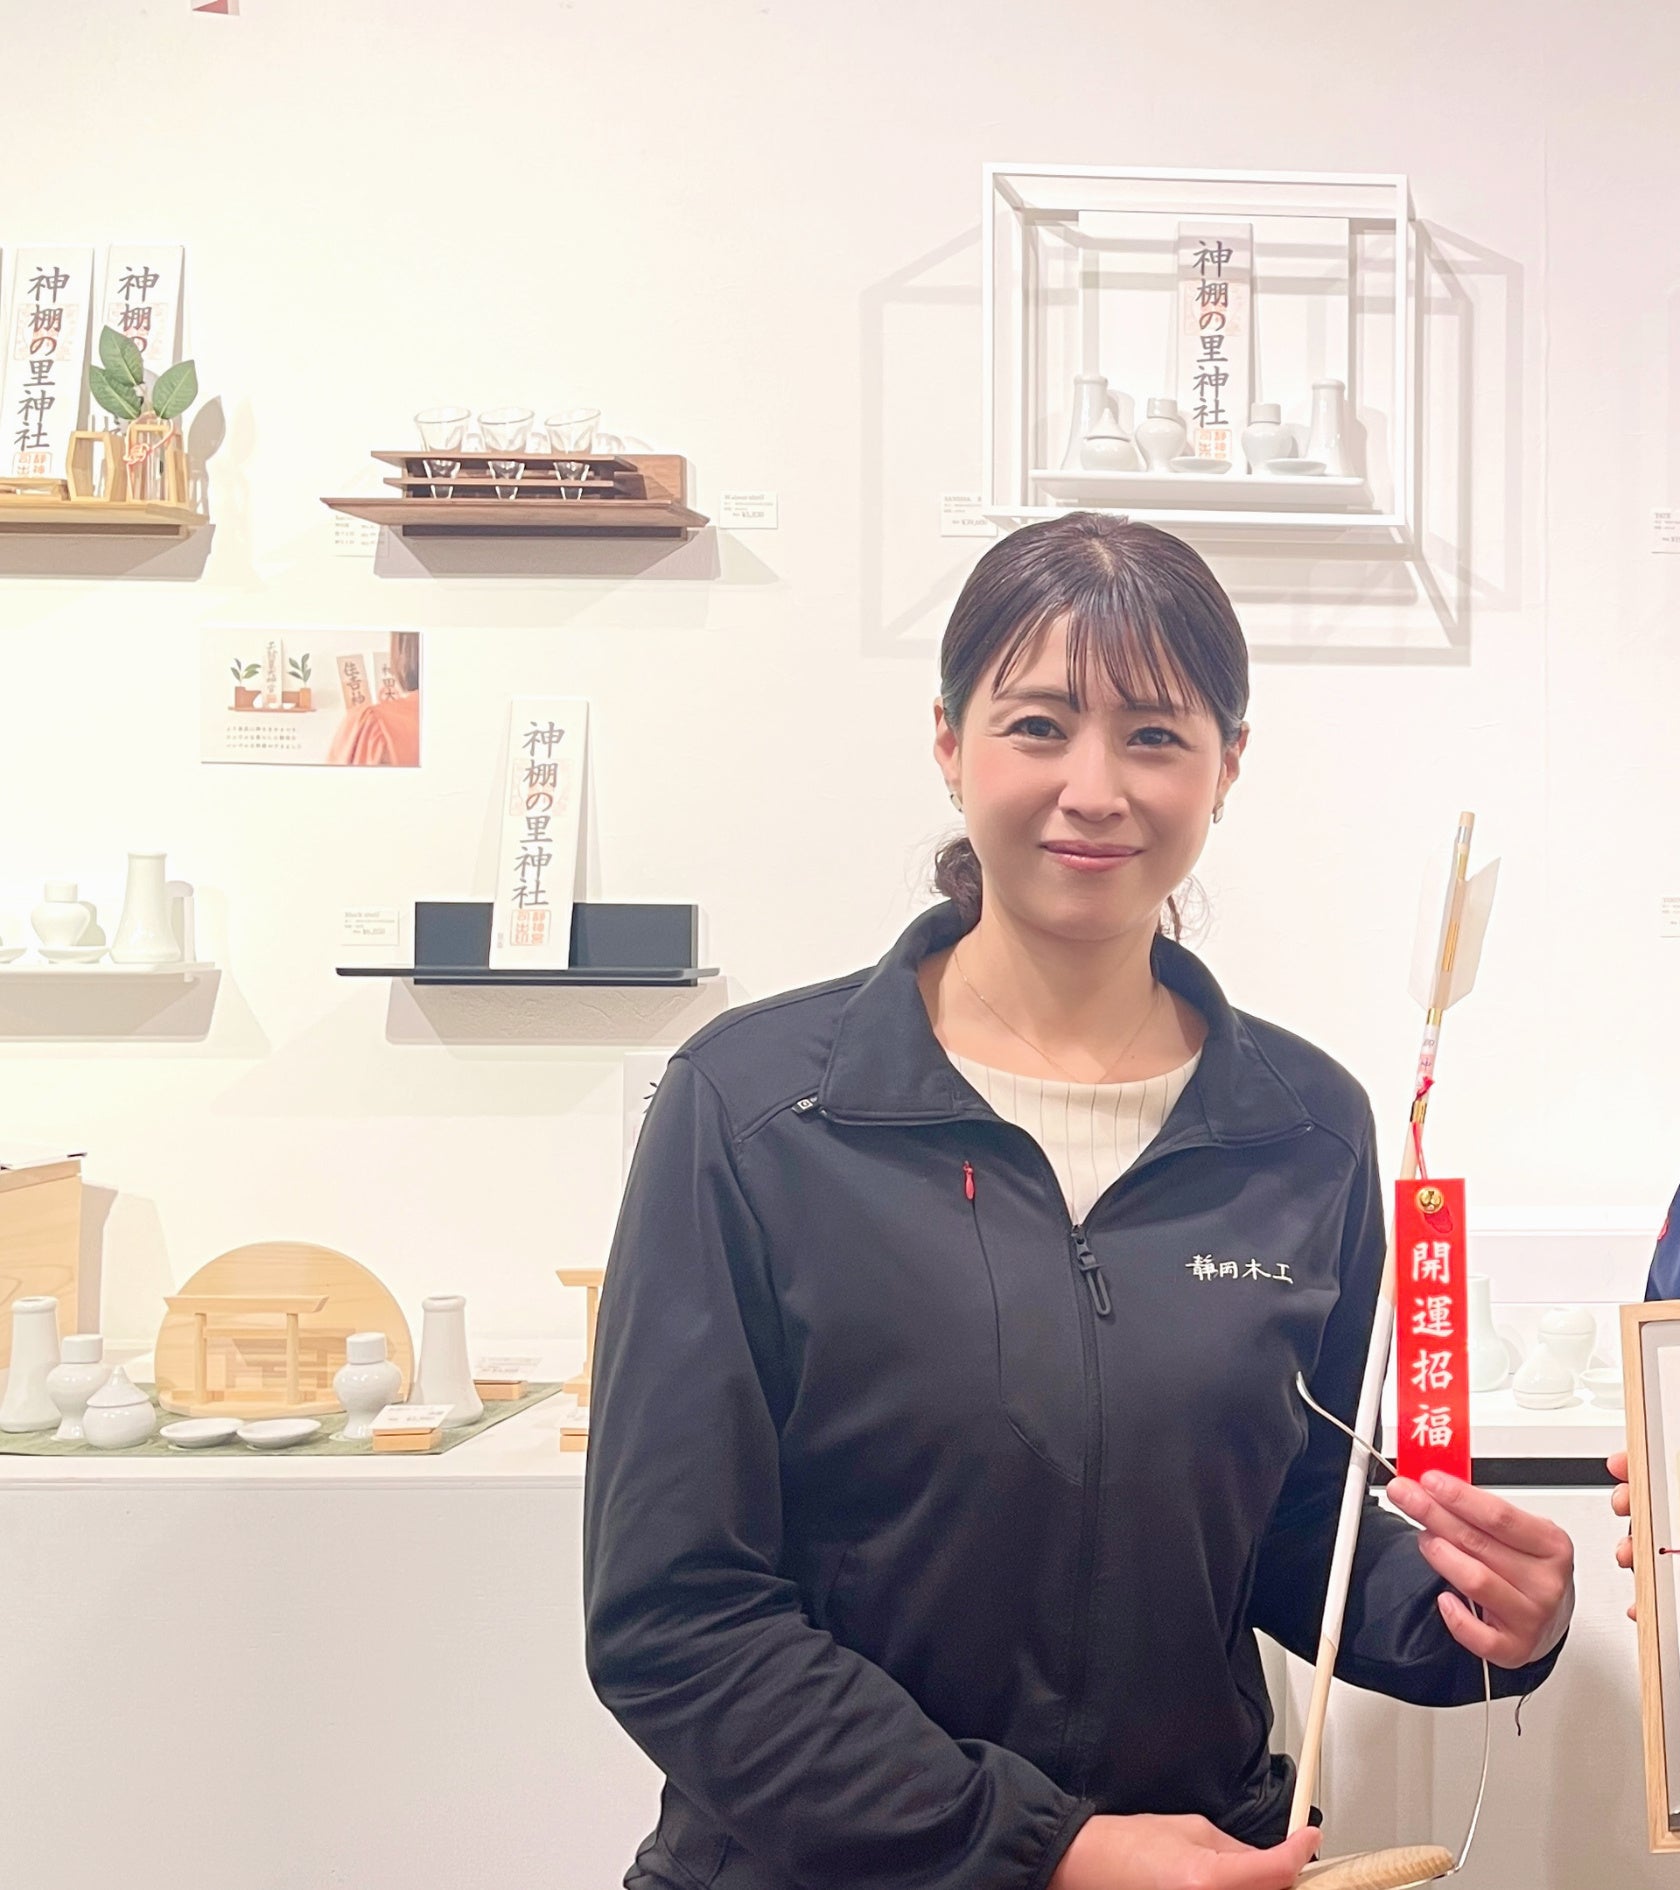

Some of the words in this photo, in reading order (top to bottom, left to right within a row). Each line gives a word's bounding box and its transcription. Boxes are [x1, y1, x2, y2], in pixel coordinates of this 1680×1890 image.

[13, 265, 71, 452] 神棚の里神社
[1191, 240, 1234, 429] 神棚の里神社
[511, 720, 565, 909] 神棚の里神社
[1184, 1253, 1294, 1285] 静岡木工
[1410, 1241, 1455, 1448] 開運招福
